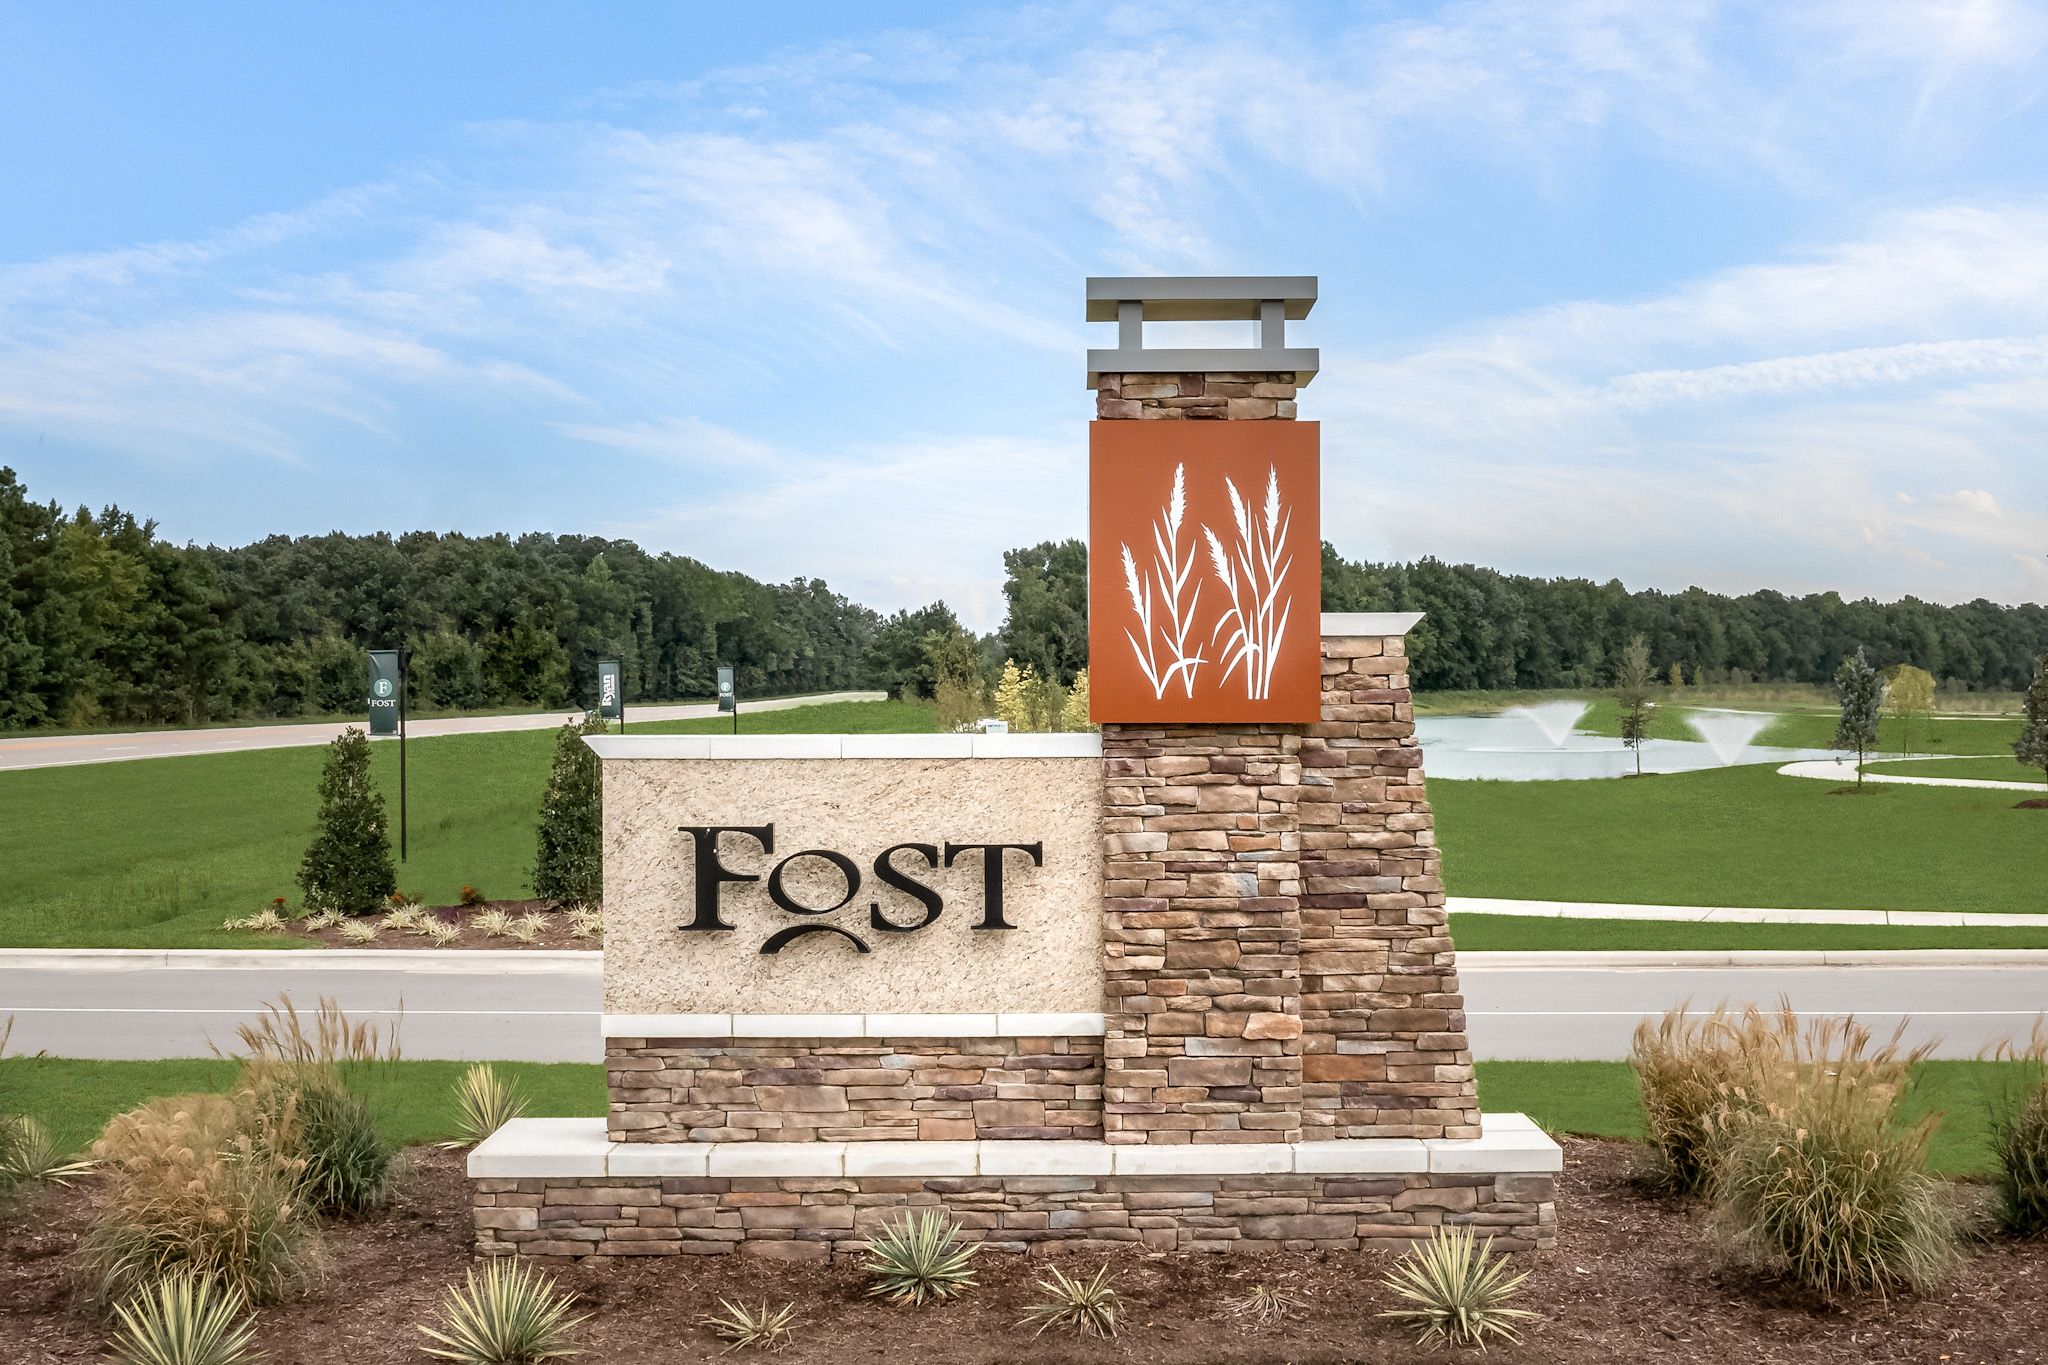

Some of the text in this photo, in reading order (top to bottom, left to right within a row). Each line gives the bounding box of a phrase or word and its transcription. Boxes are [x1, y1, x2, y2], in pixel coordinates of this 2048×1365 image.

[378, 681, 388, 694] F
[602, 674, 615, 706] Ryan
[371, 699, 396, 707] FOST
[677, 823, 1043, 931] FOST
